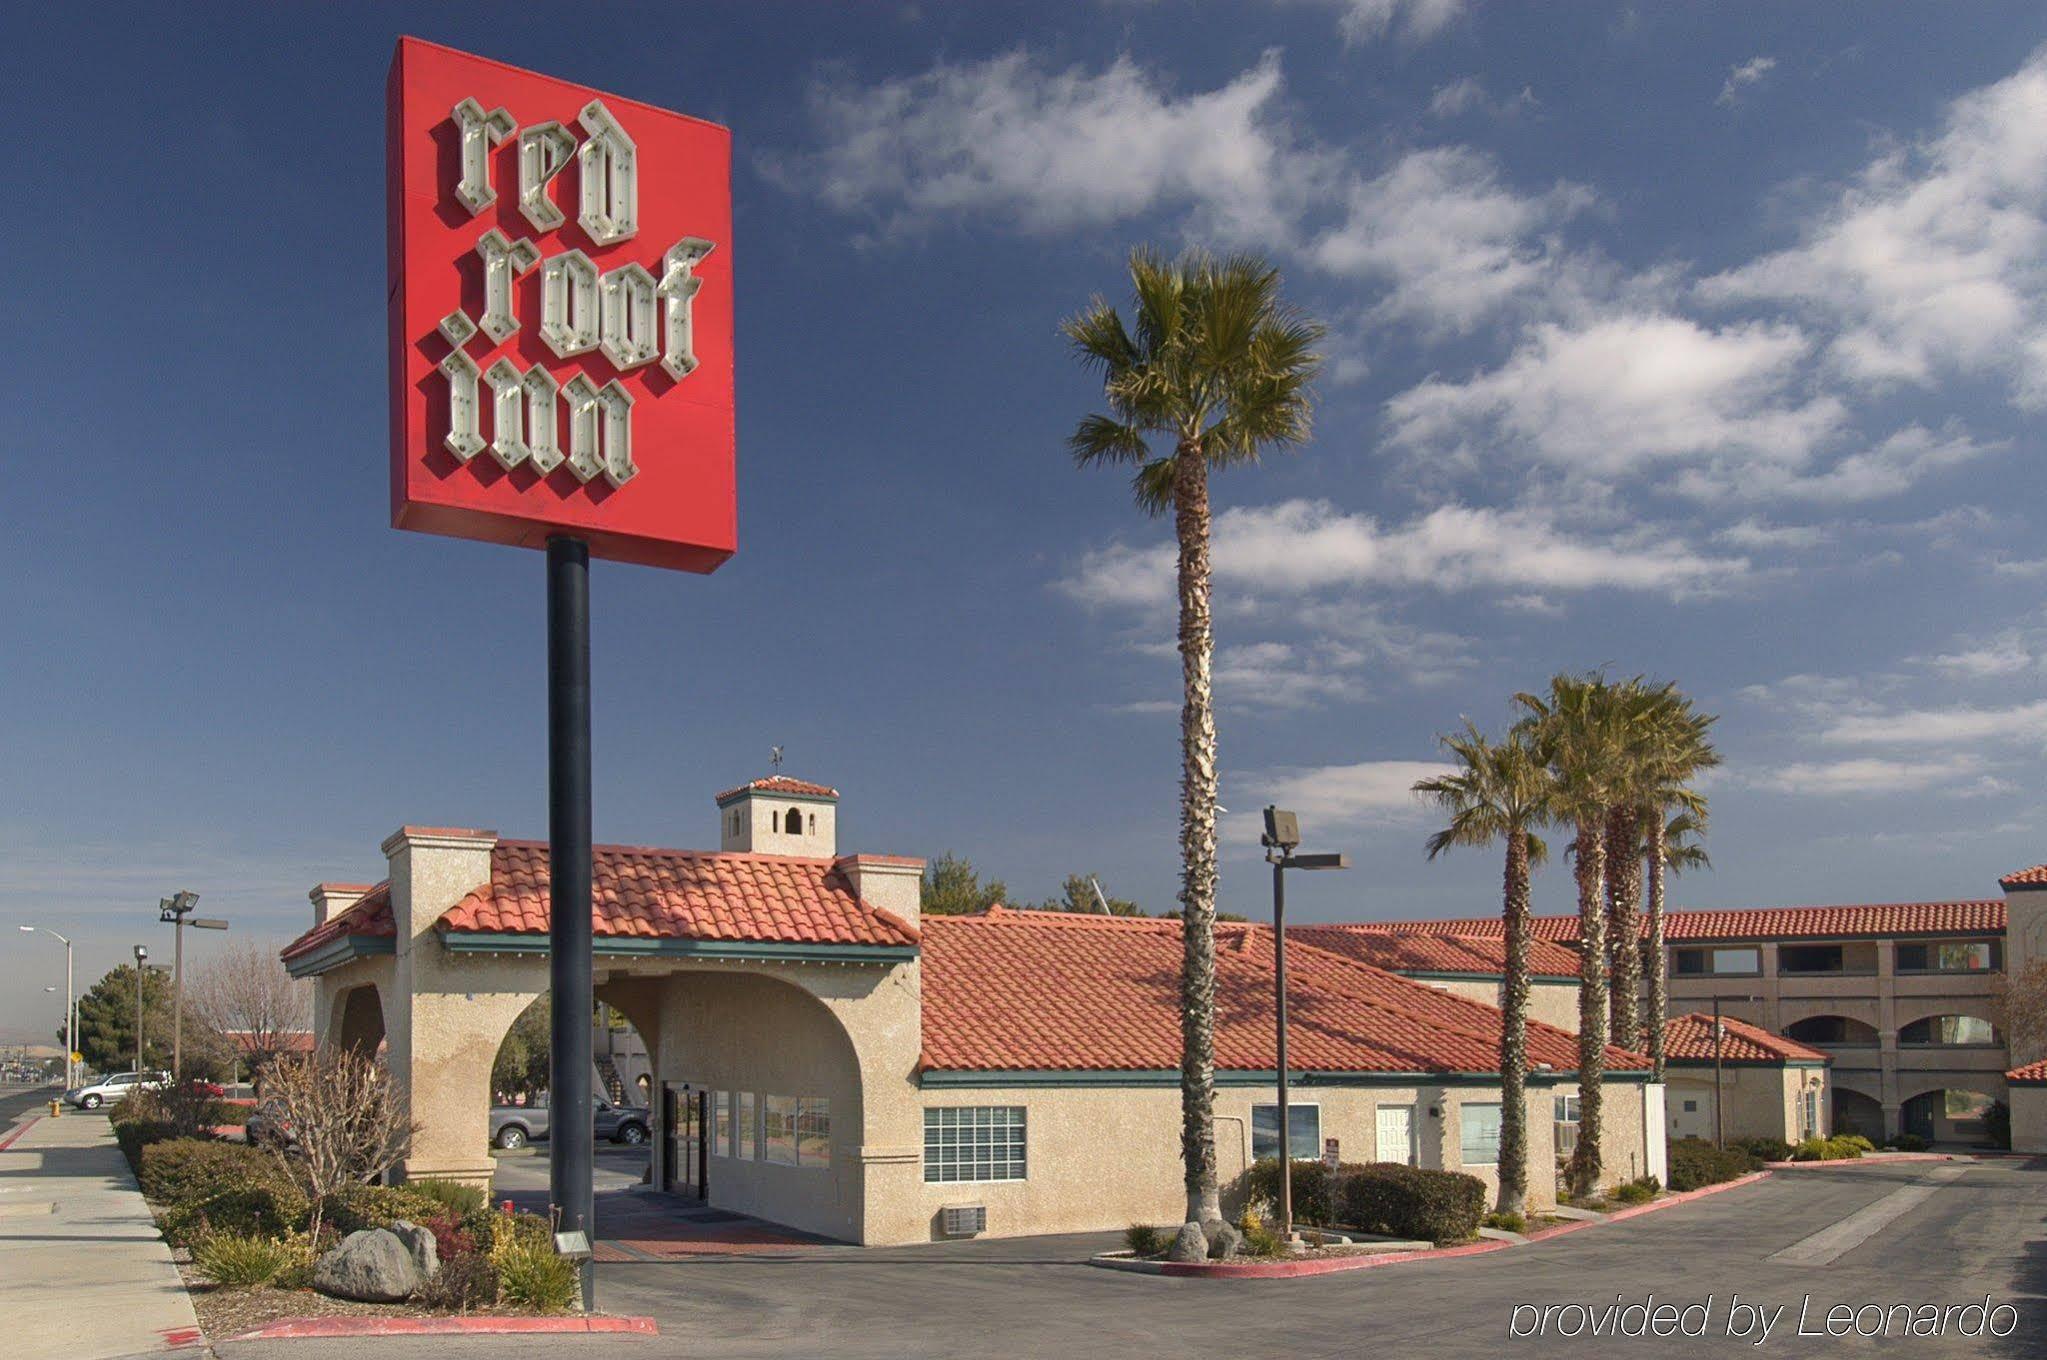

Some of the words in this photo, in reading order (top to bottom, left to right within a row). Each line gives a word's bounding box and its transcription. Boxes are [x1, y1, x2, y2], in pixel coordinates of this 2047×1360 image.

[454, 96, 640, 247] red
[475, 226, 718, 384] roof
[438, 307, 641, 491] inn
